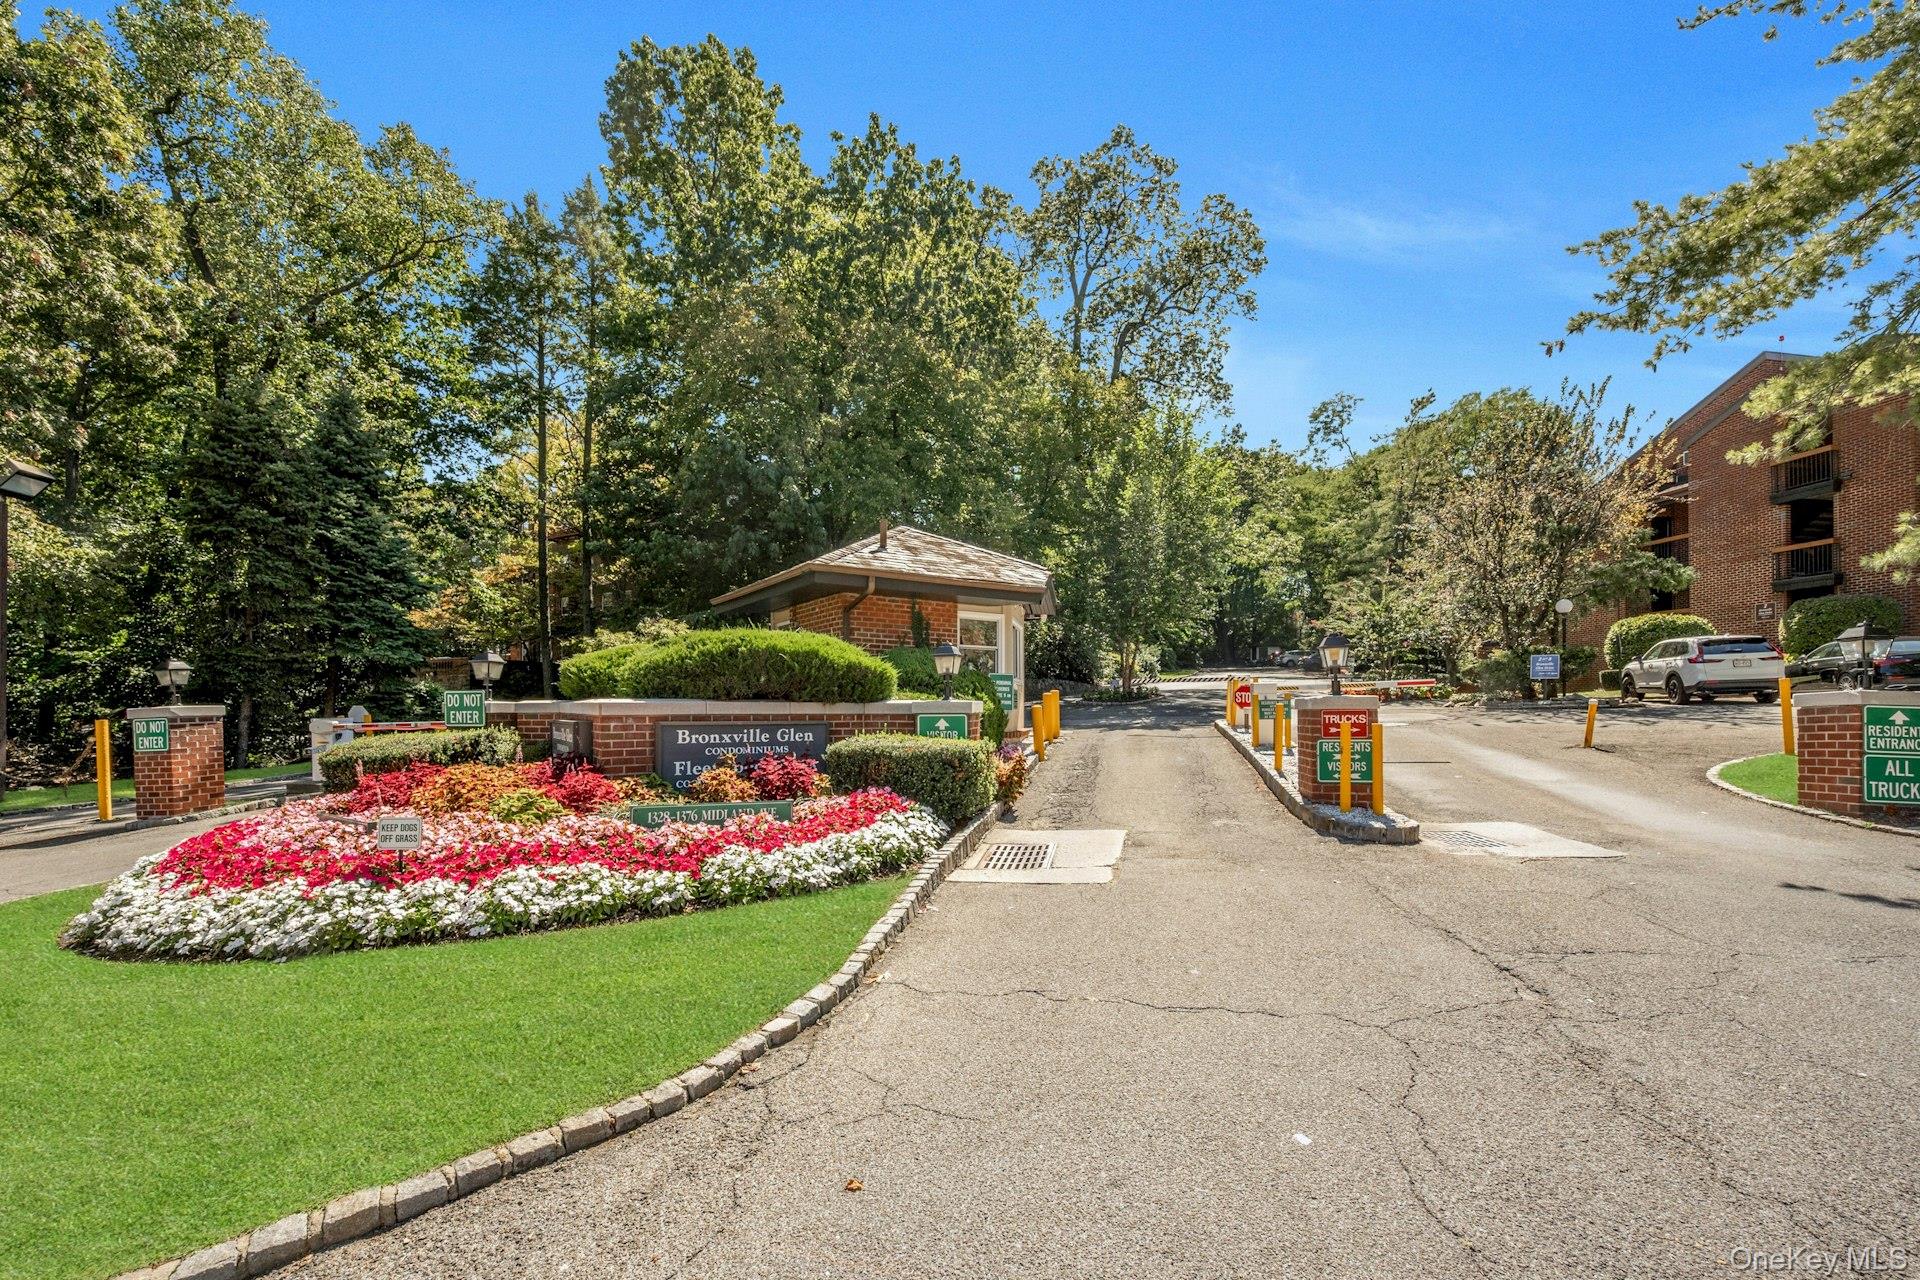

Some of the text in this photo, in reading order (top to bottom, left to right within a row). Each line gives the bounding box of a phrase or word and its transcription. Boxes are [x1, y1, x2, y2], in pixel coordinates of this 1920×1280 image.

[447, 694, 481, 707] DO NOT
[1235, 691, 1251, 704] STO
[450, 710, 480, 723] ENTER
[1323, 714, 1367, 724] TRUCKS
[135, 721, 165, 734] DO NOT
[138, 736, 164, 749] ENTER
[676, 728, 815, 745] Bronxville Glen
[705, 745, 789, 756] CONDOMINIUMS
[1322, 742, 1371, 752] RESNTS
[1327, 761, 1367, 771] VISORS
[1885, 760, 1915, 777] ALL
[647, 810, 698, 824] 1328-1376
[381, 823, 418, 831] KEEP DOGS
[380, 834, 418, 843] OFF GRASS
